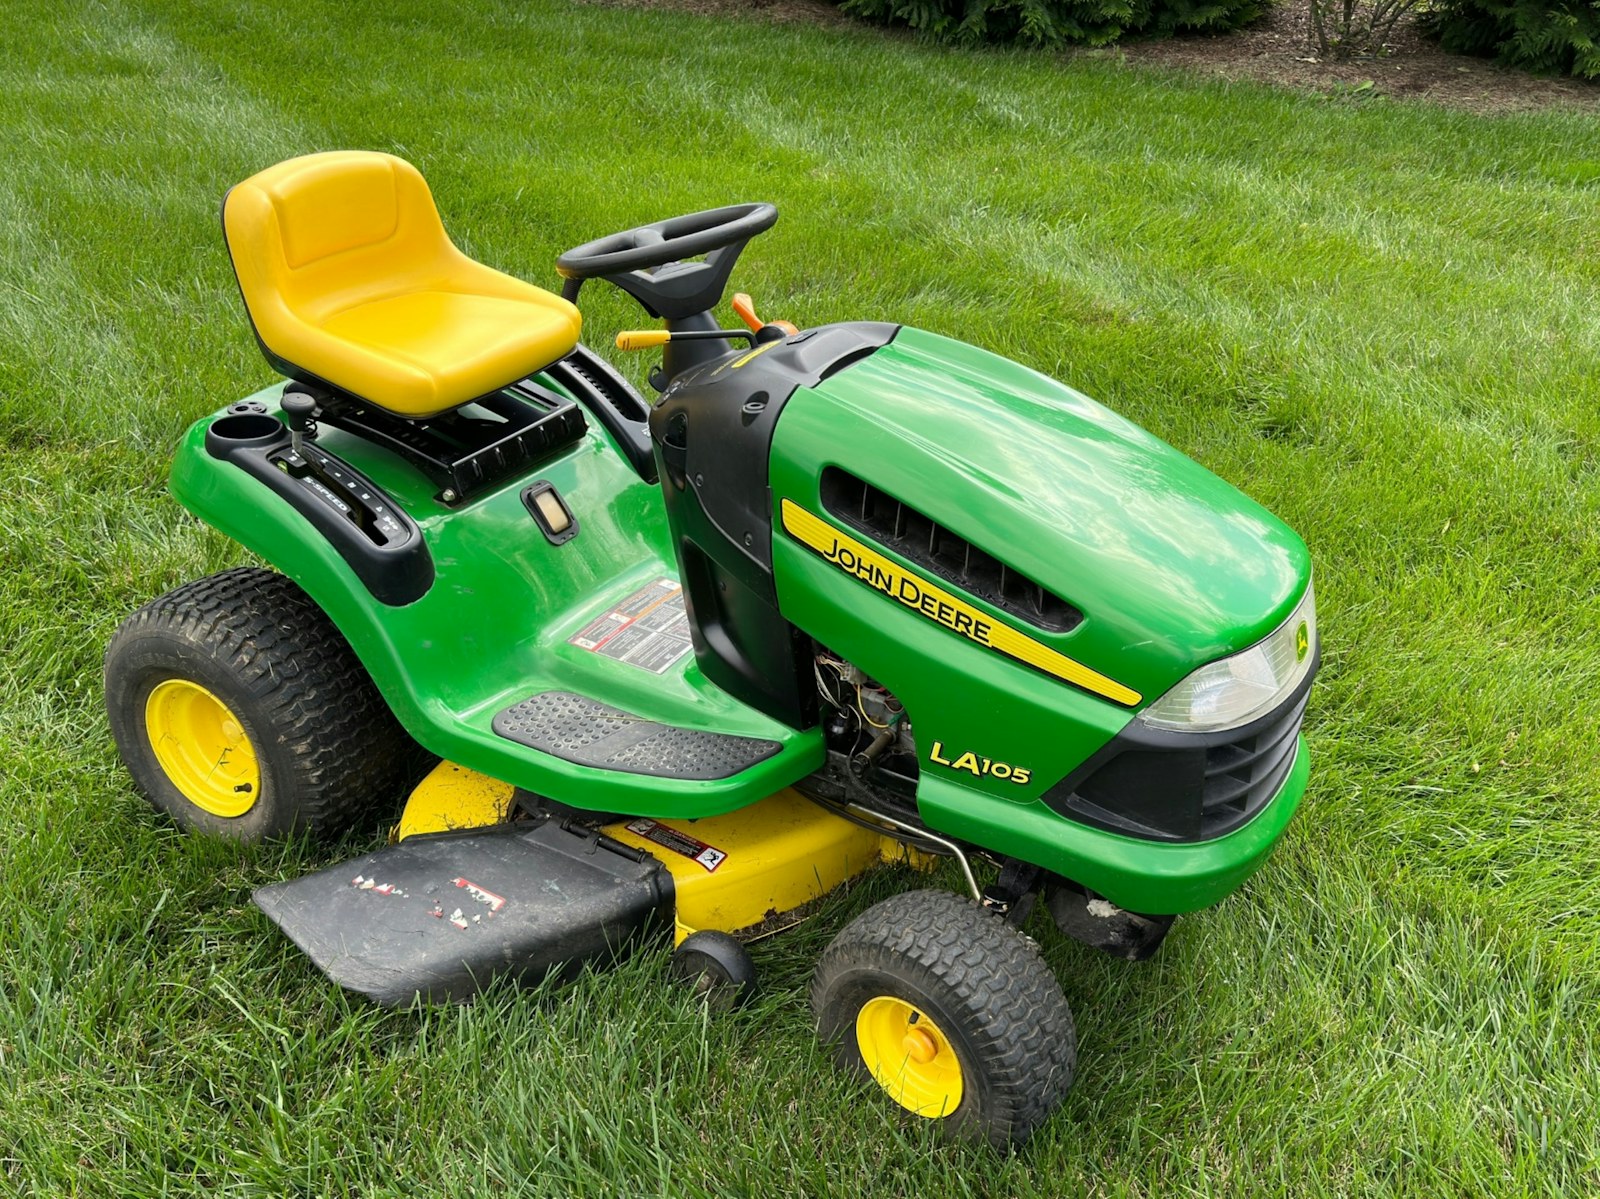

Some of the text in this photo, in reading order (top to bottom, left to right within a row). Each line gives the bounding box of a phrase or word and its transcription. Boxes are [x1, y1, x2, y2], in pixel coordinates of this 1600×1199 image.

[823, 538, 893, 593] JOHN
[899, 576, 992, 644] DEERE
[930, 741, 1032, 785] LA105
